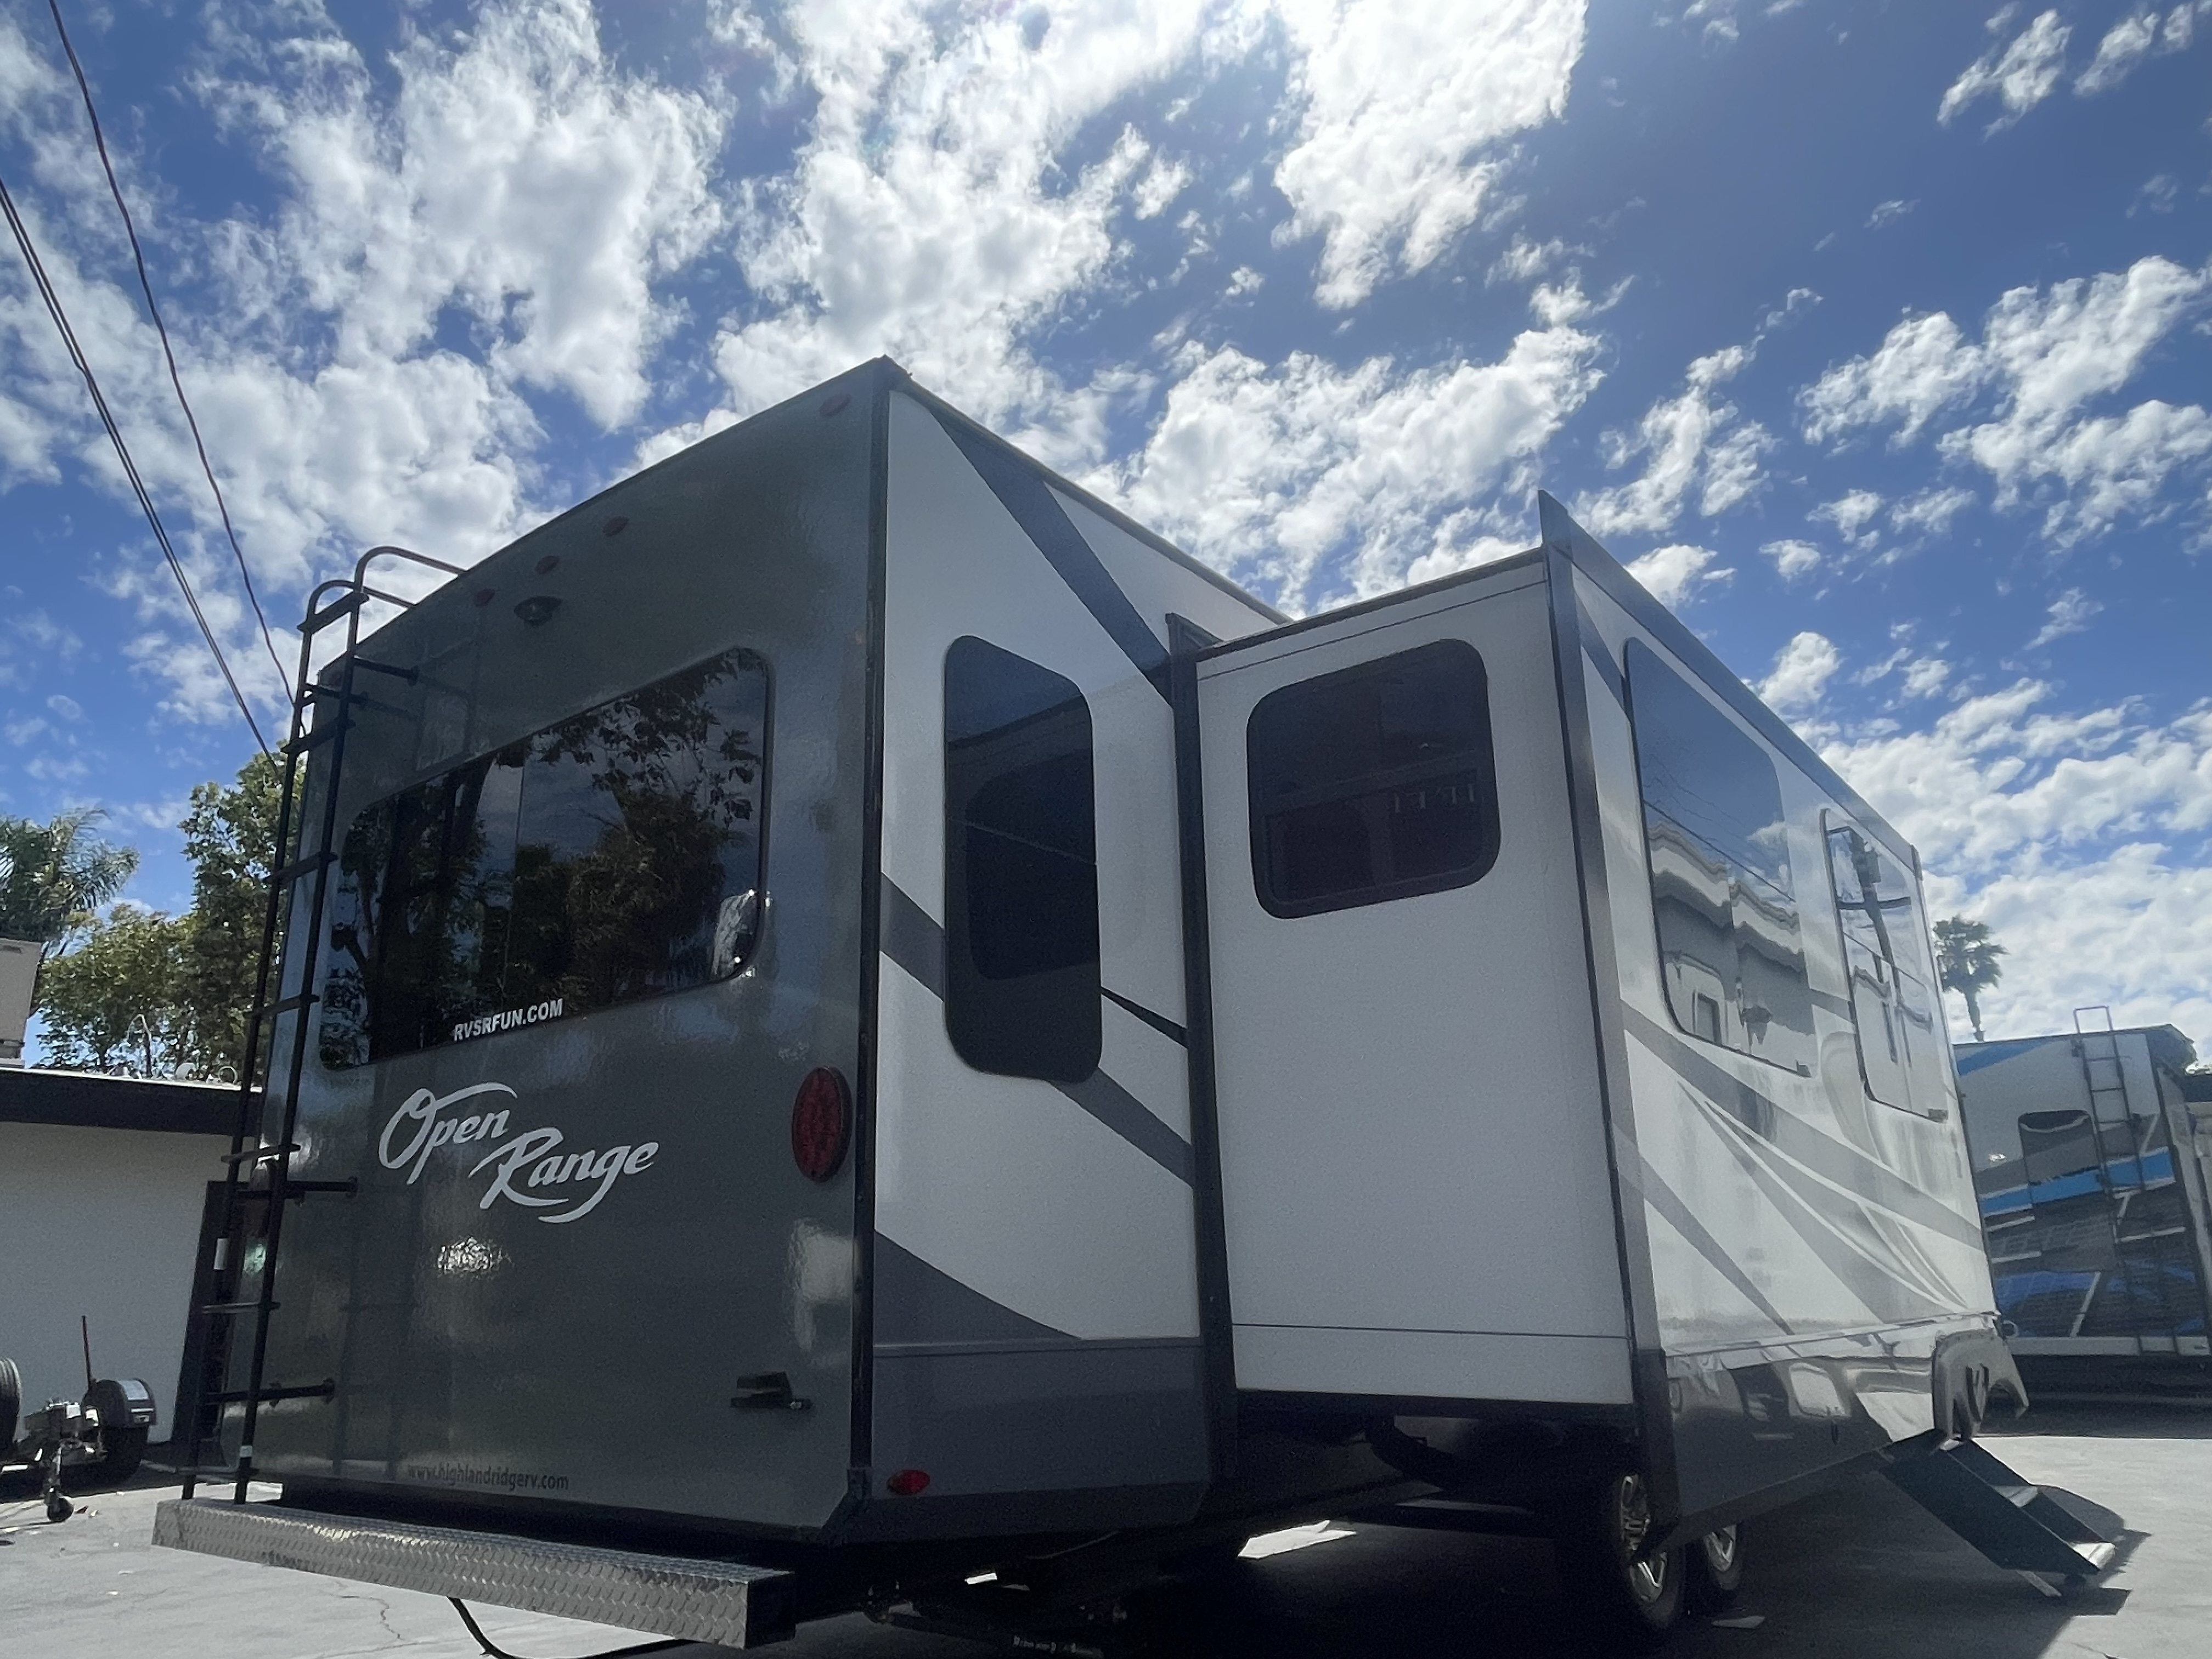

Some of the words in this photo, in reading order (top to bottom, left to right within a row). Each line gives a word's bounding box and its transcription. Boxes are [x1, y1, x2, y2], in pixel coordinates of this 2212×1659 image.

[453, 998, 563, 1041] RVSRFUN.COM
[379, 1082, 518, 1185] Open
[468, 1127, 659, 1223] Range
